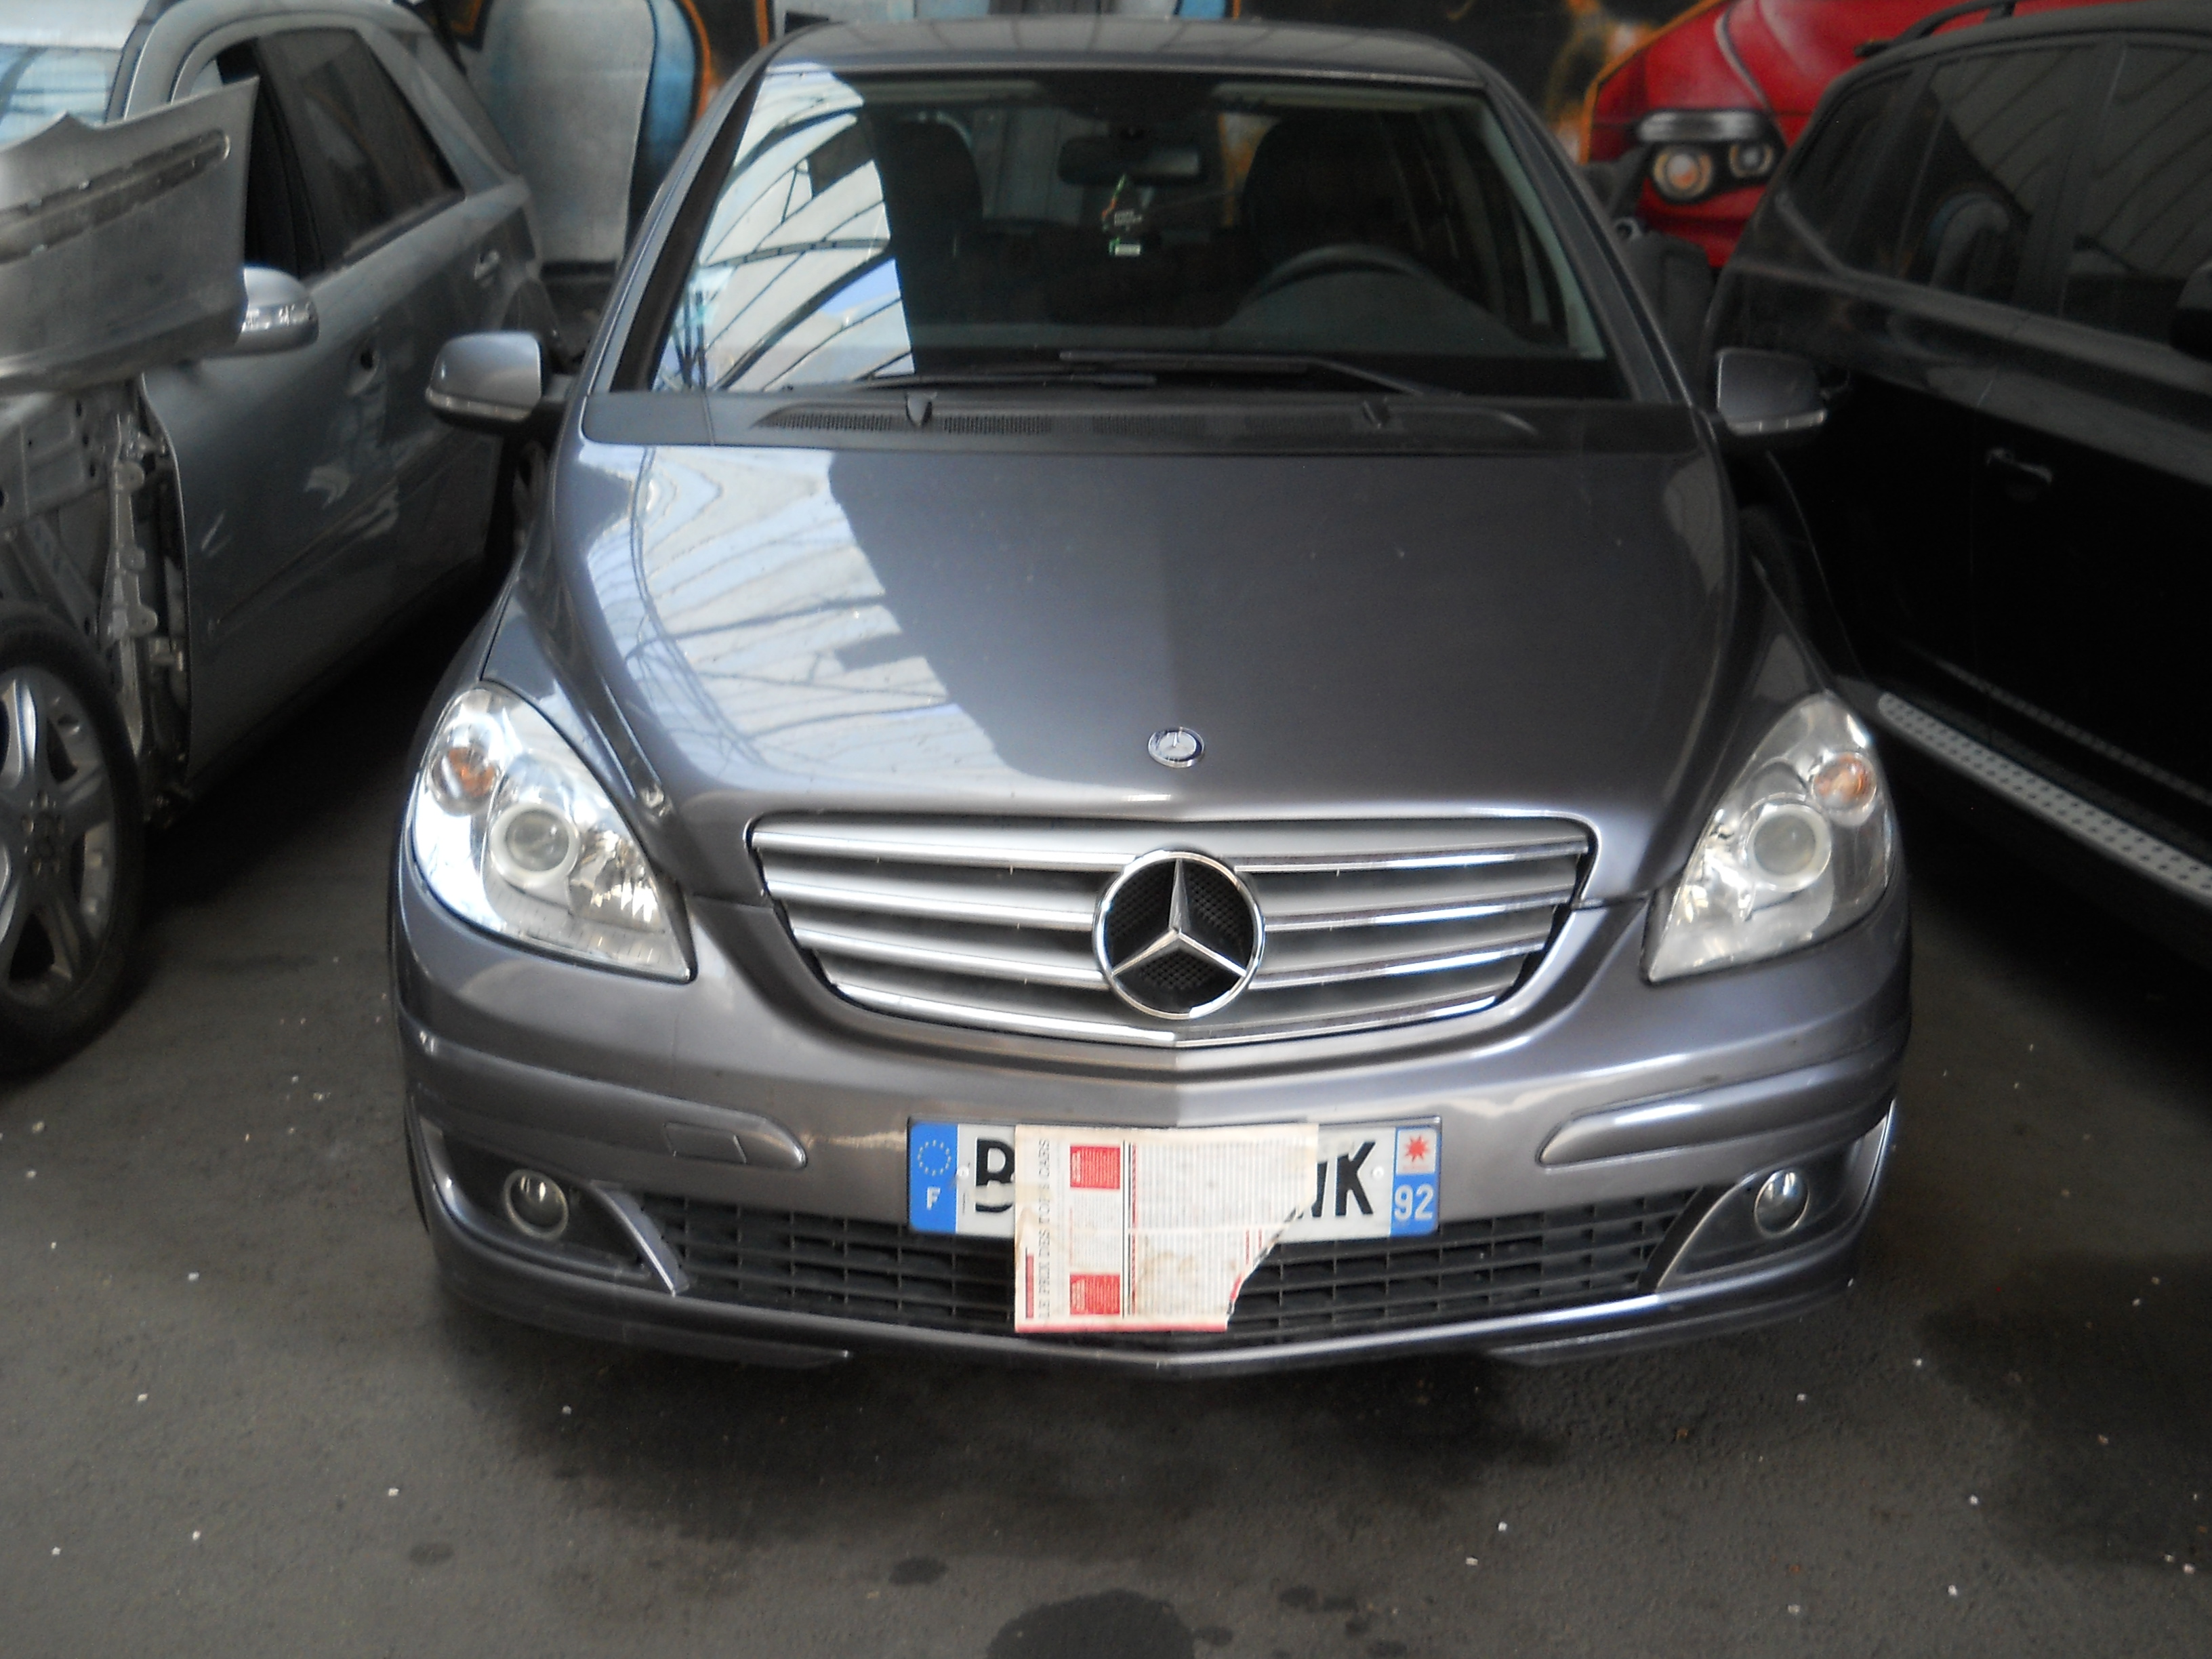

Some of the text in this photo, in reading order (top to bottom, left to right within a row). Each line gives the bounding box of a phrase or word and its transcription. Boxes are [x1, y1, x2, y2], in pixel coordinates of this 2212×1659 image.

[1038, 1139, 1050, 1179] CARS
[926, 1186, 941, 1211] F
[1393, 1184, 1434, 1221] 92
[1038, 1229, 1050, 1258] DES
[1038, 1261, 1050, 1295] PRIX
[1038, 1299, 1050, 1319] LE
